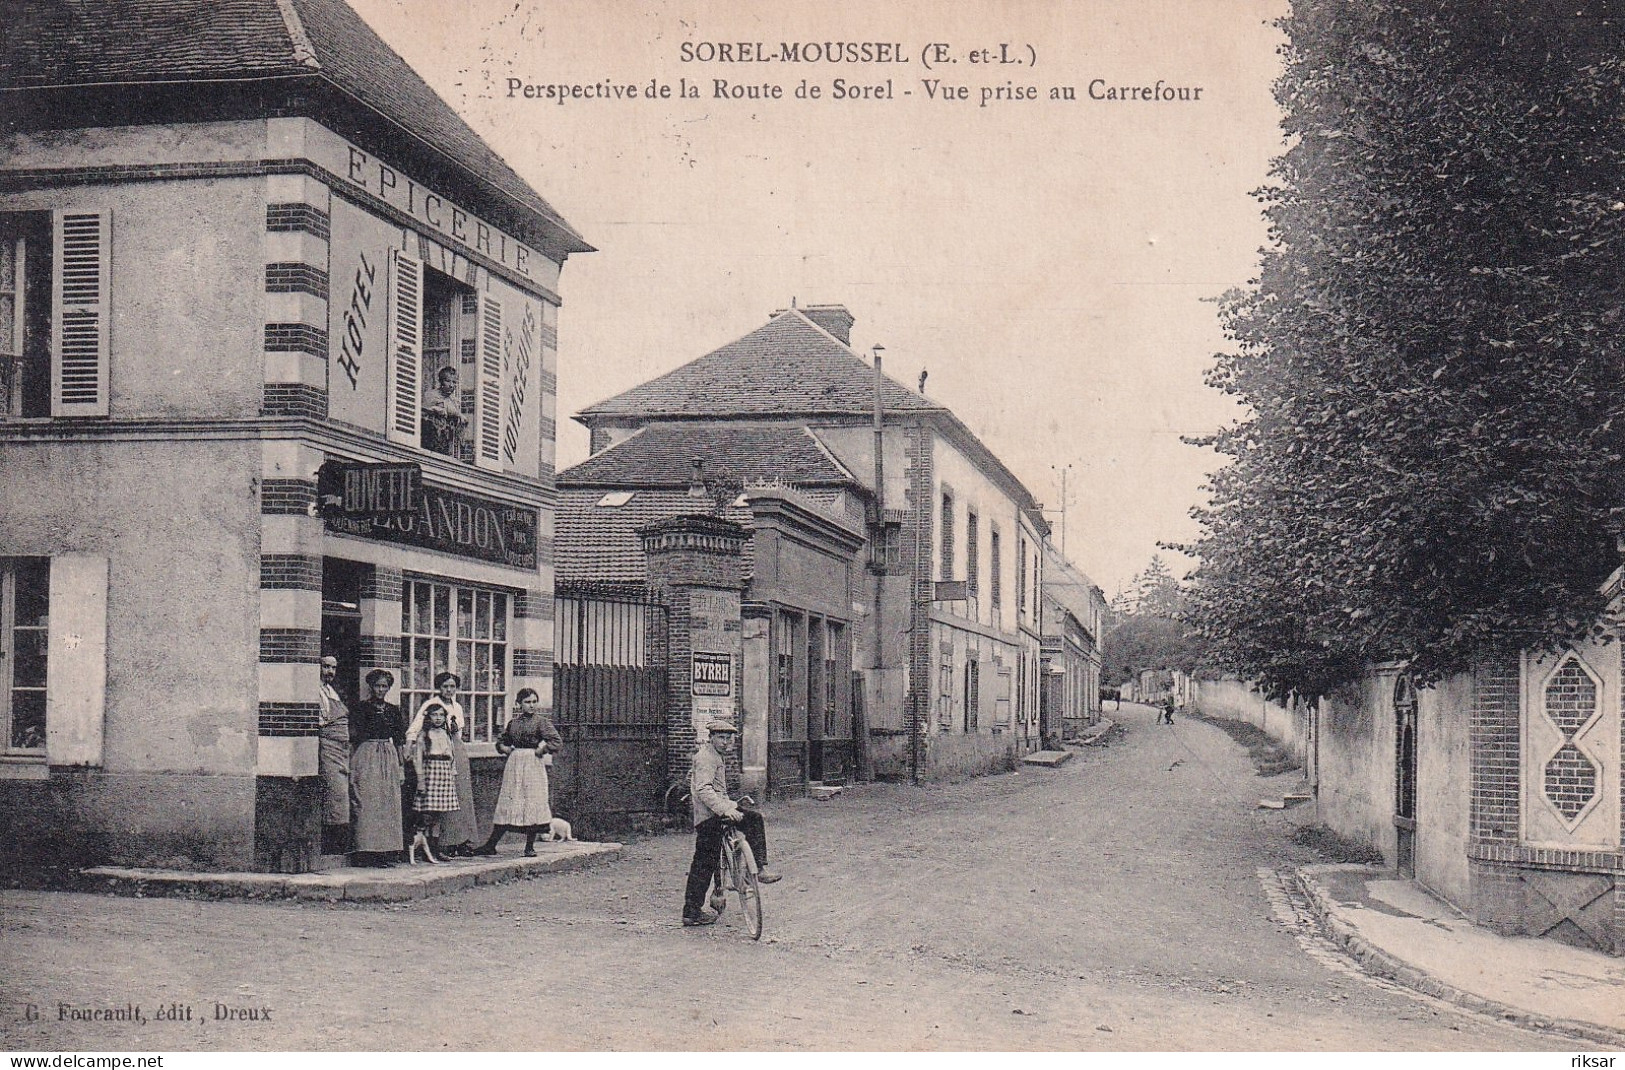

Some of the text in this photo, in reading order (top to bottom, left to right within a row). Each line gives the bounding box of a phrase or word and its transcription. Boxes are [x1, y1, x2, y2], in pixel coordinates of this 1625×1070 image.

[347, 145, 530, 276] EPICERIE
[337, 251, 375, 391] HÔTEL
[503, 301, 535, 465] VOYAGEURS
[345, 468, 418, 511] BUVETTE
[694, 662, 729, 681] BYRRH
